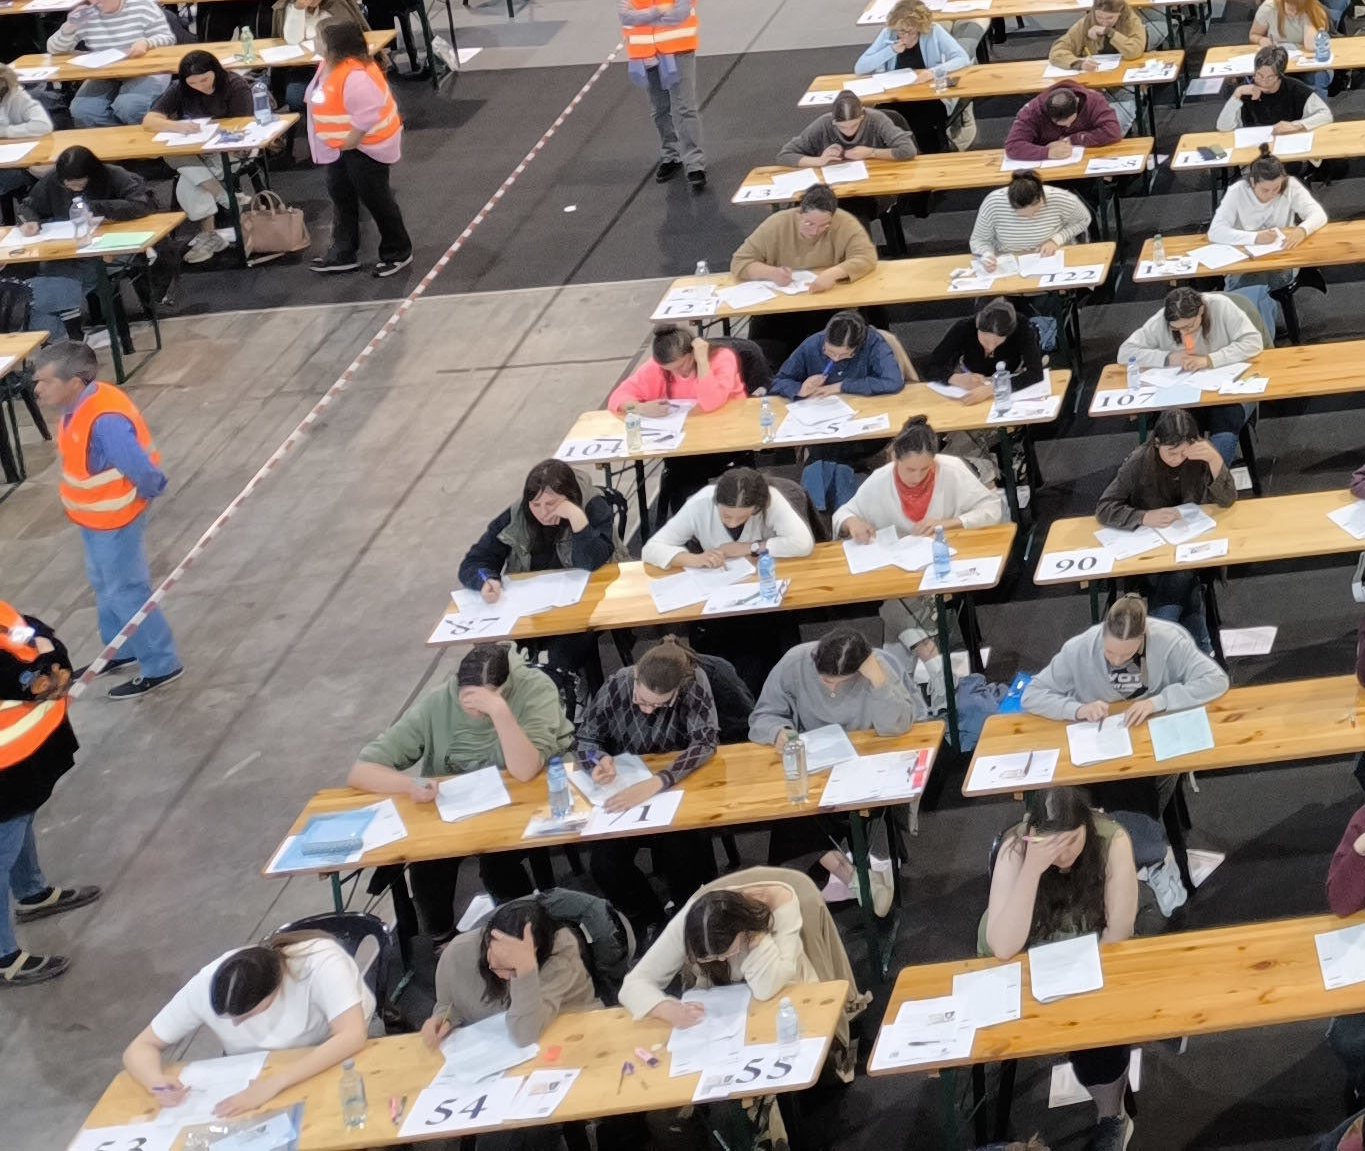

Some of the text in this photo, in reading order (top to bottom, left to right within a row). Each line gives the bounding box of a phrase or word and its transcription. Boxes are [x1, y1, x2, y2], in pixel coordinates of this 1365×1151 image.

[1047, 270, 1097, 284] 122
[1100, 392, 1157, 410] 107
[1055, 556, 1098, 574] 90
[734, 1057, 795, 1085] 55
[424, 1094, 490, 1127] 54
